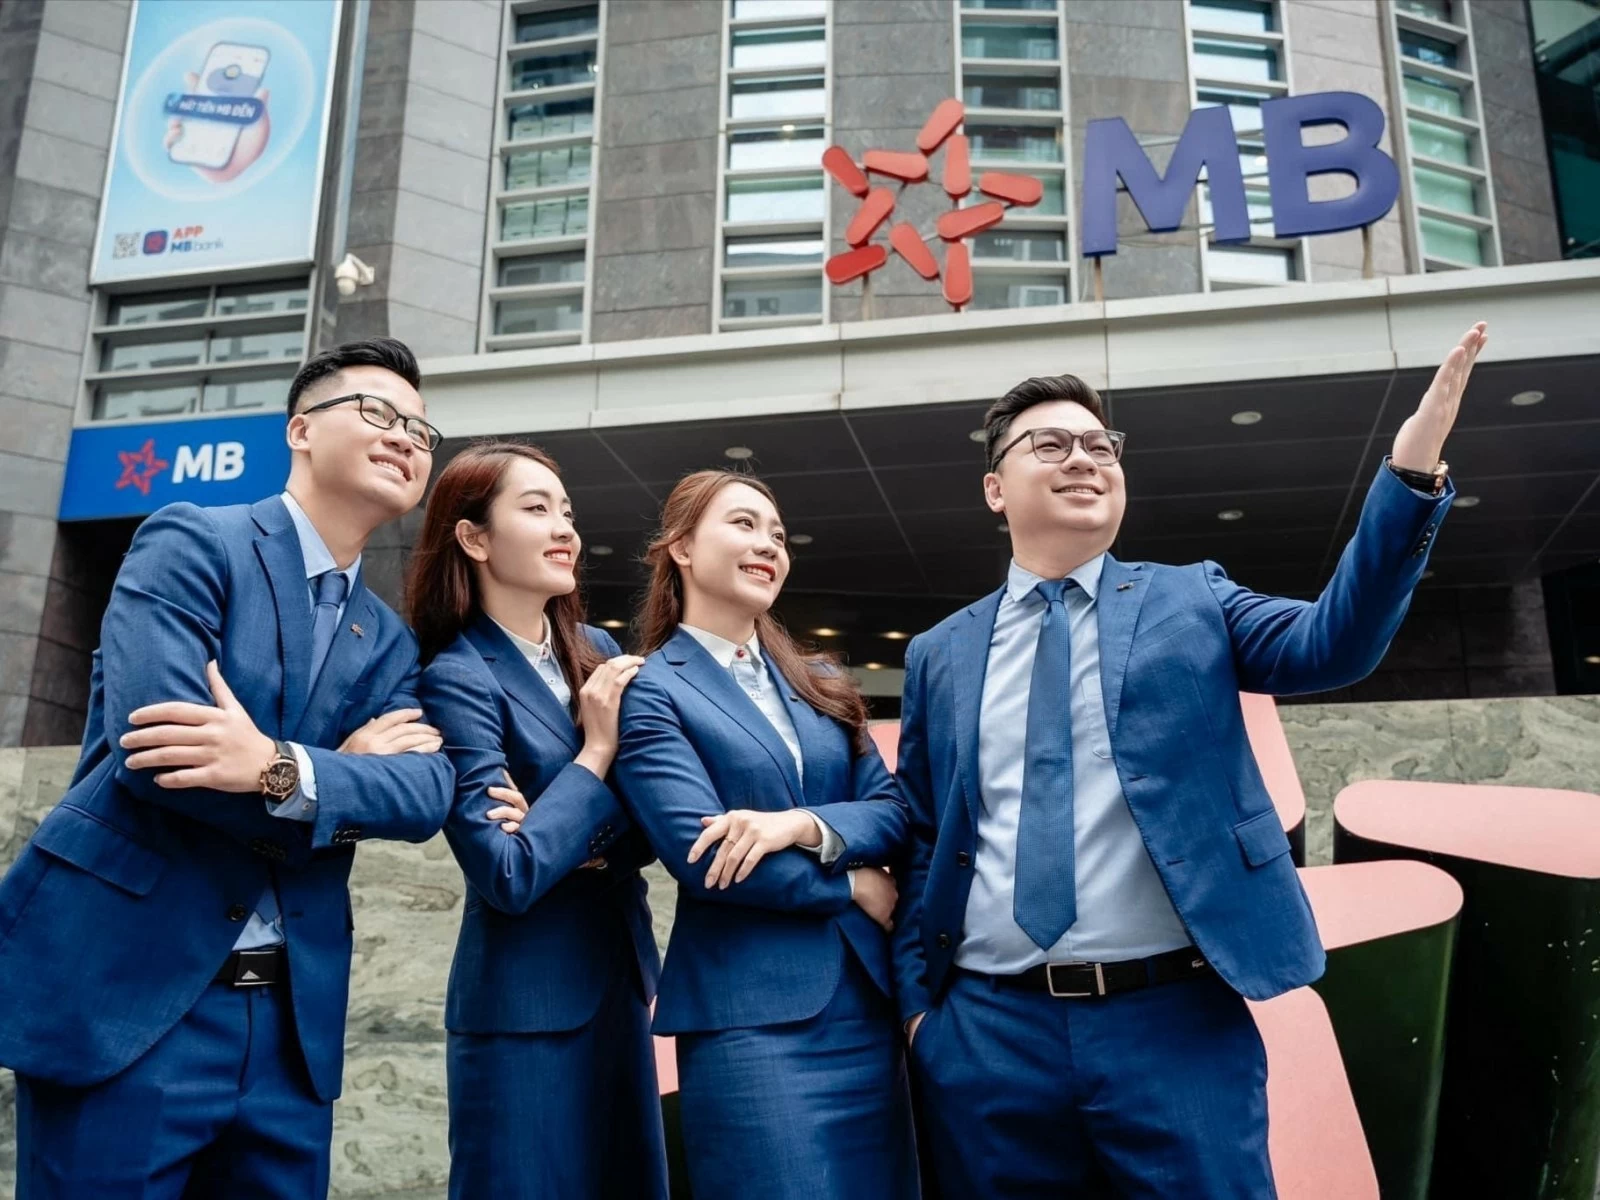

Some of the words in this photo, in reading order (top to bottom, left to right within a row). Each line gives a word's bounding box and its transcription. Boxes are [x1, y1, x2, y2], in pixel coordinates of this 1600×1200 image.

[1082, 91, 1401, 258] MB
[173, 225, 204, 240] APP
[172, 441, 245, 484] MB
